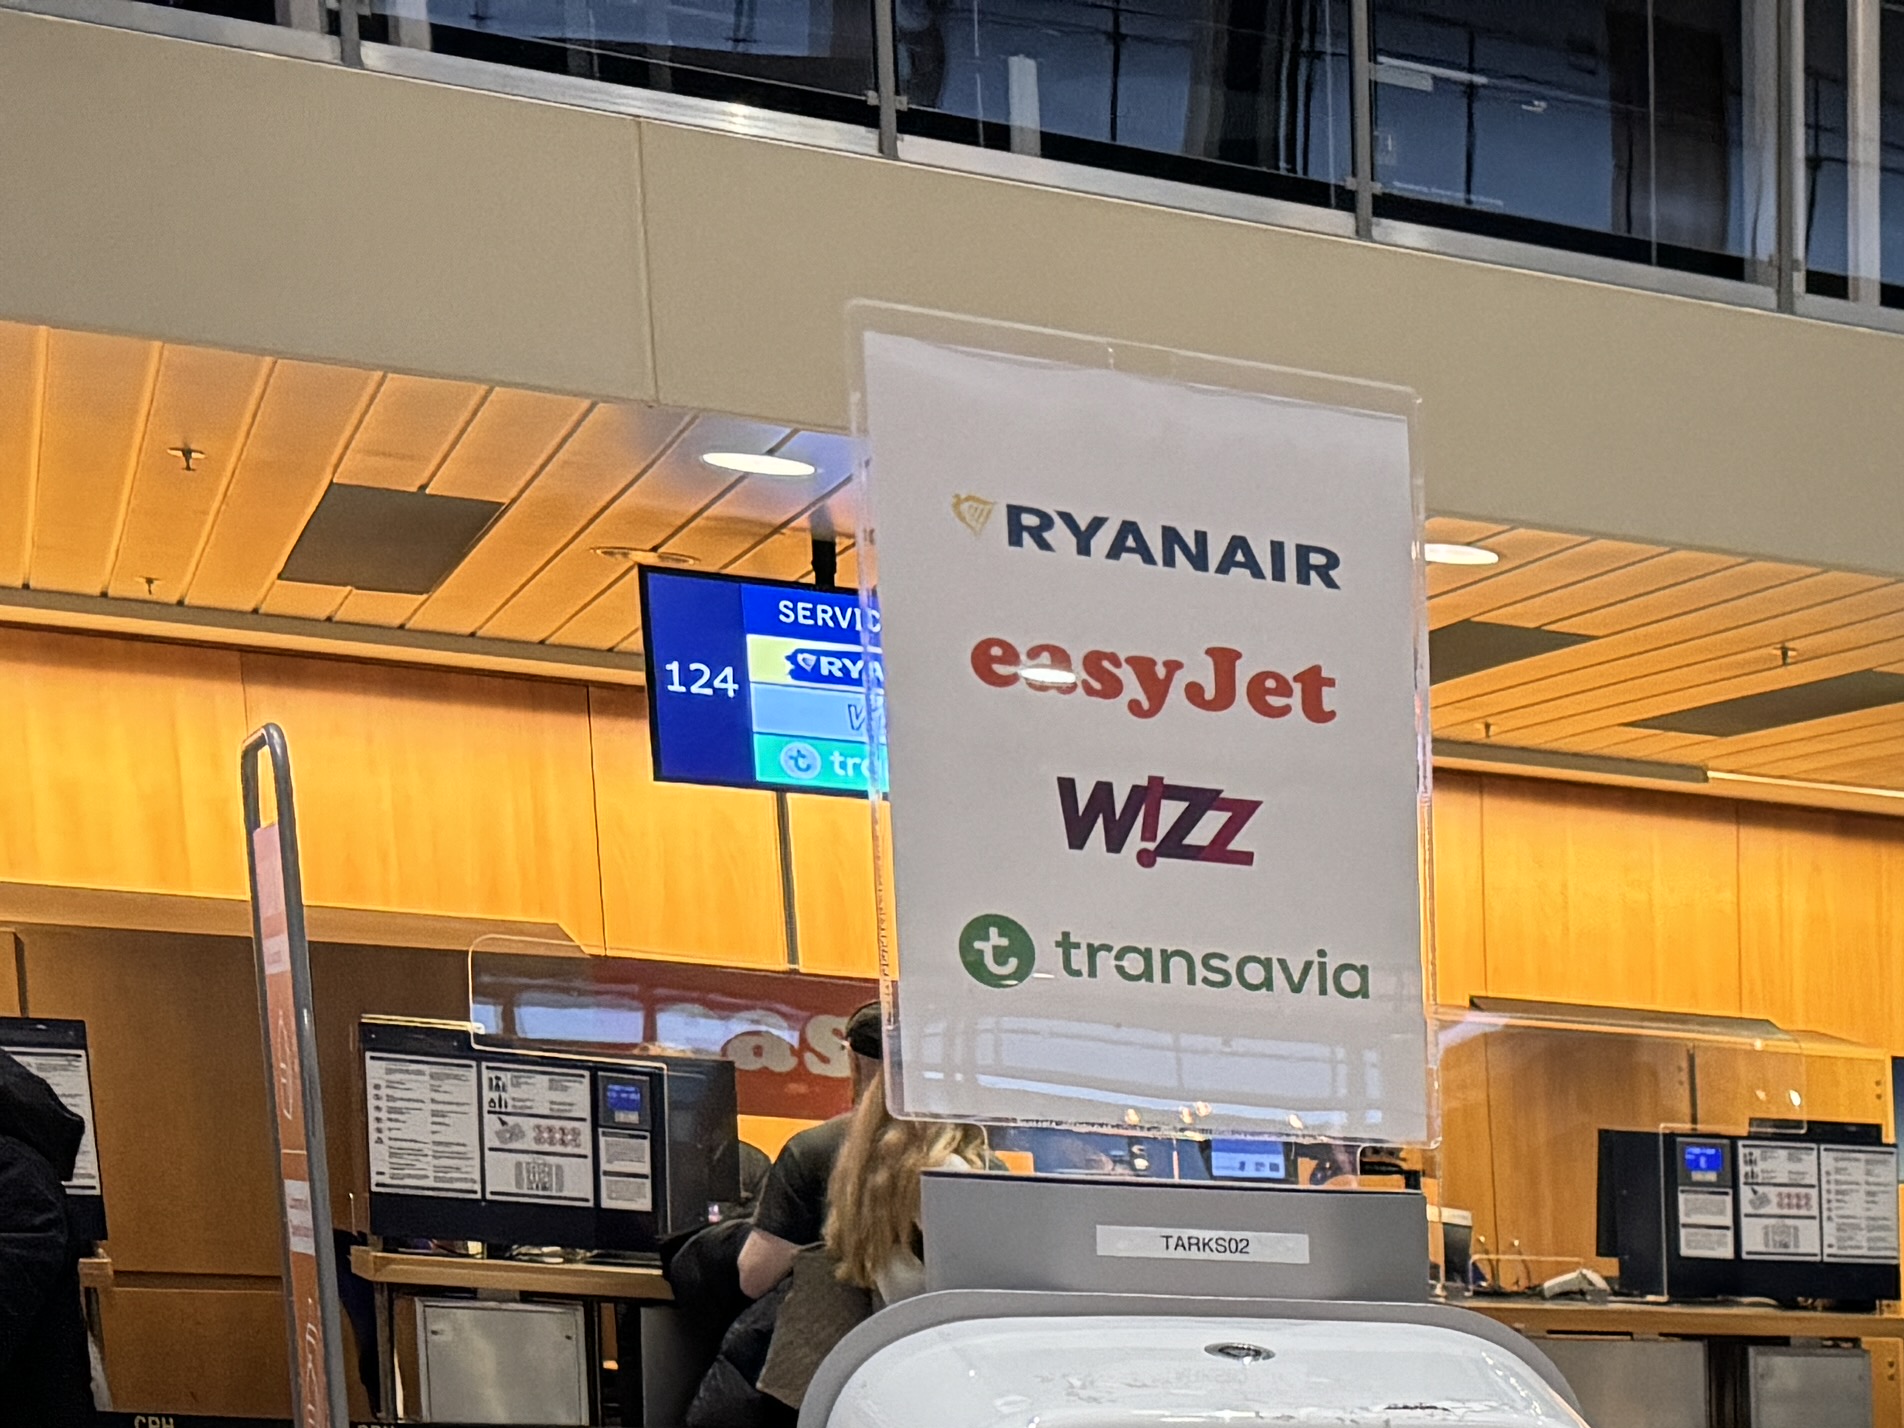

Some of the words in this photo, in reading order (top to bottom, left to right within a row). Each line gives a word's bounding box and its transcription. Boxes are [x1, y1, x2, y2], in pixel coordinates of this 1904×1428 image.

[1005, 503, 1342, 590] RYANAIR
[665, 660, 739, 698] 124
[970, 636, 1338, 725] easyJet
[1054, 931, 1371, 1000] transavia
[1160, 1234, 1250, 1255] TARKS02
